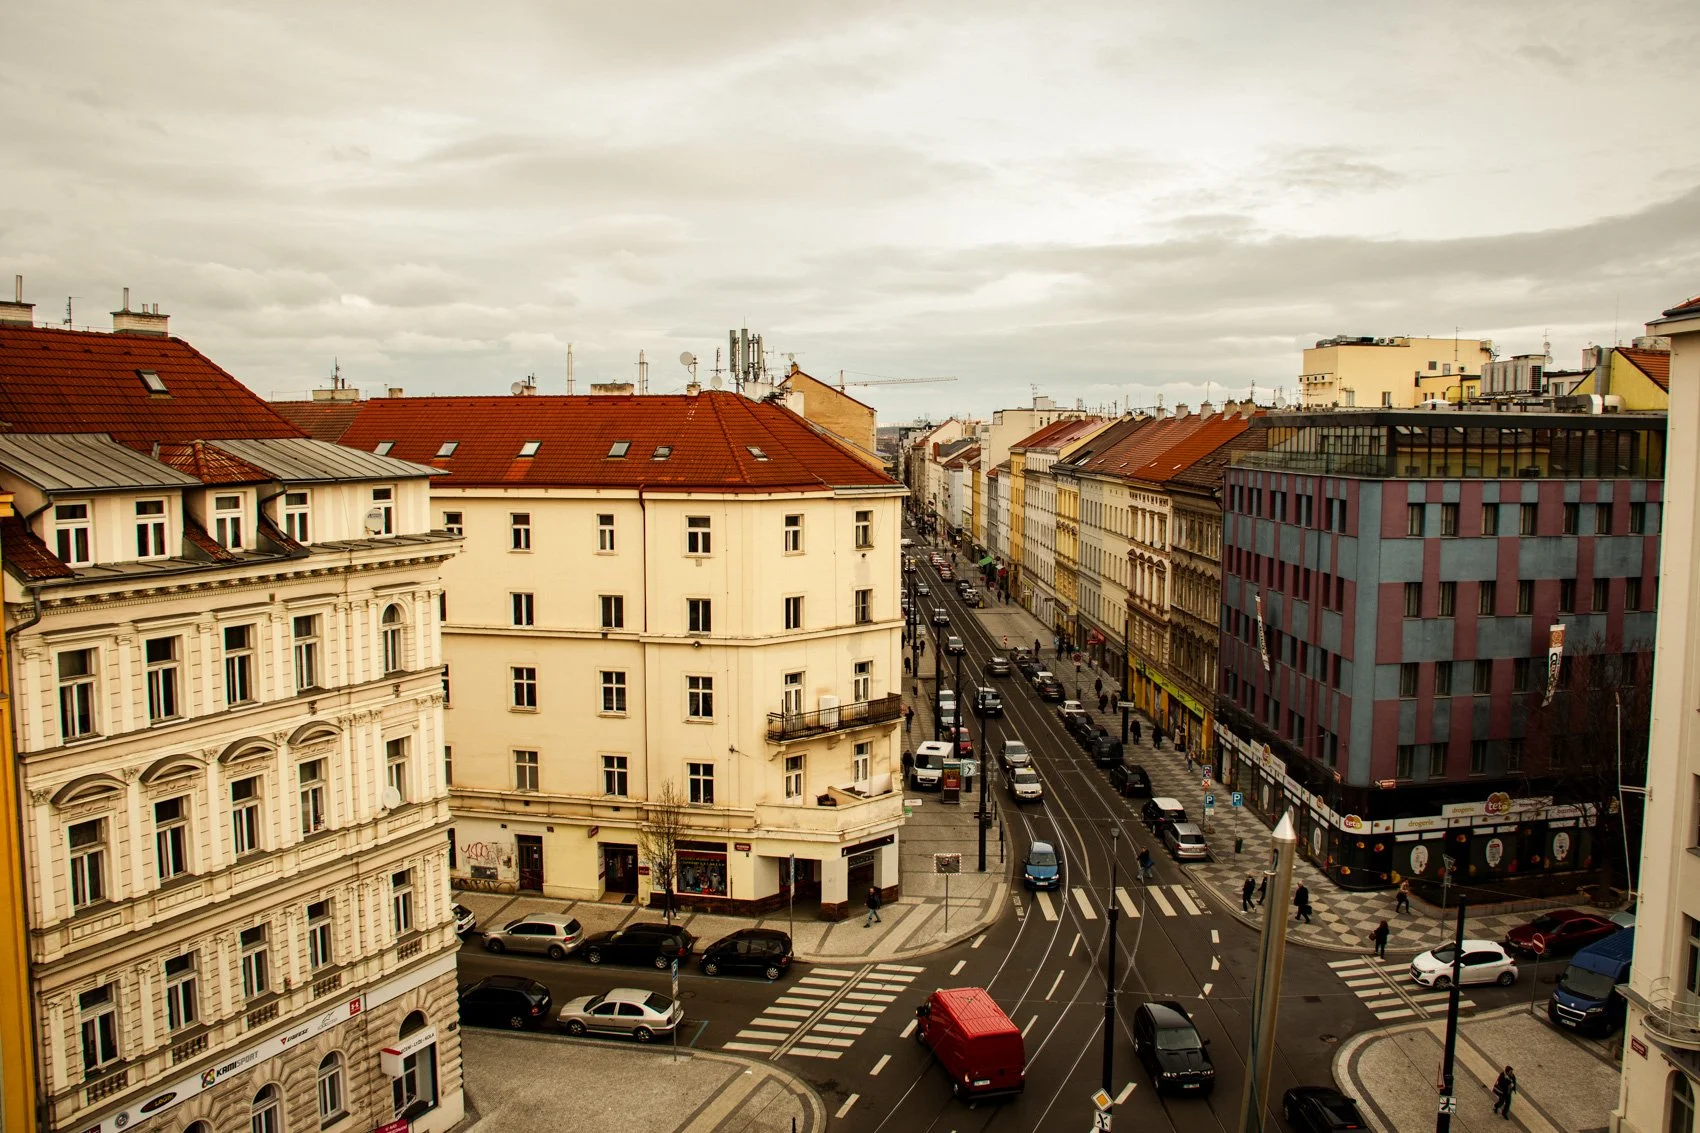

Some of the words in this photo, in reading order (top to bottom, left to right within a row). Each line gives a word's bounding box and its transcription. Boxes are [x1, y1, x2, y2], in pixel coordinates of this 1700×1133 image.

[1206, 795, 1213, 804] P
[1233, 794, 1241, 803] P
[1488, 801, 1508, 811] teta
[1345, 819, 1360, 828] teta
[1408, 818, 1434, 828] drogerie
[216, 1050, 259, 1078] KAMISPORT
